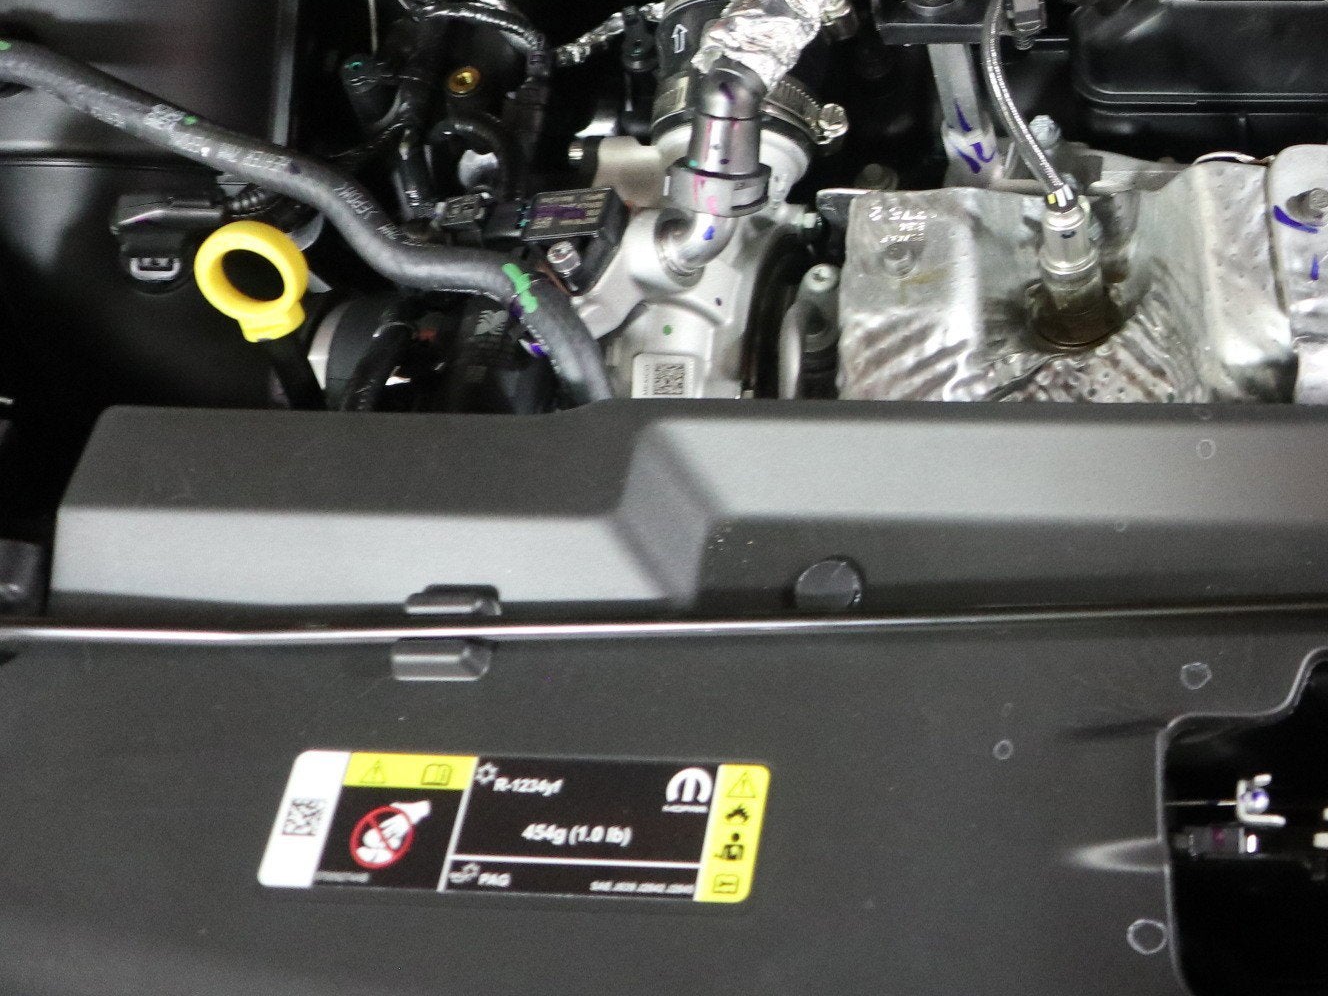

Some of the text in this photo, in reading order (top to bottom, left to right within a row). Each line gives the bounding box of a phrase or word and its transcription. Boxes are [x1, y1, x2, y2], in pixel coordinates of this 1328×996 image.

[493, 776, 565, 797] R-1234yf
[521, 822, 633, 848] 454g (1.0 lb)
[477, 871, 512, 888] PAG
